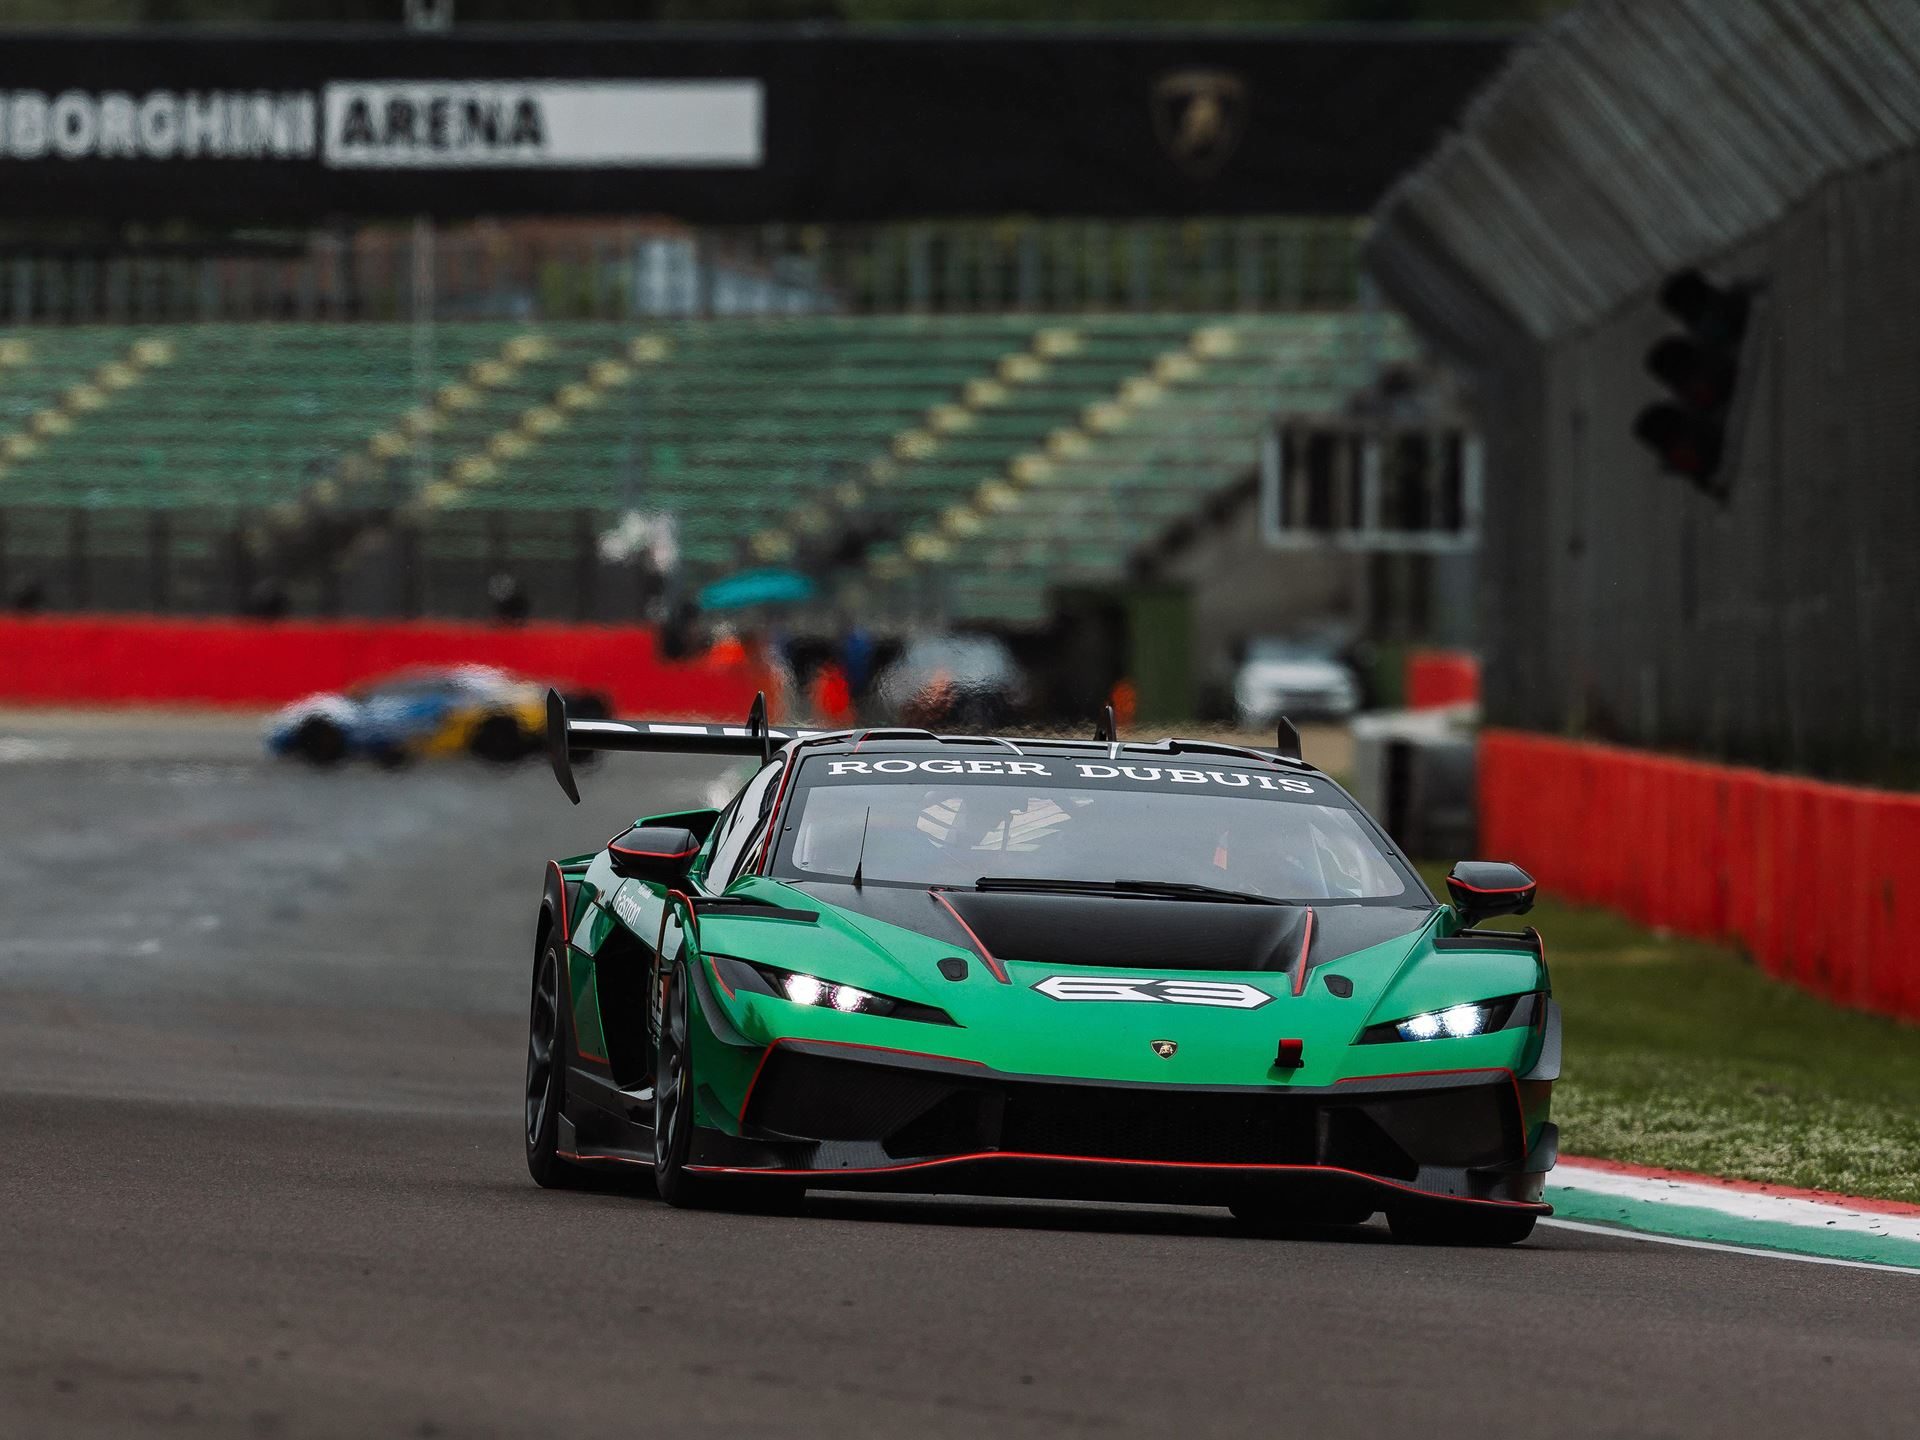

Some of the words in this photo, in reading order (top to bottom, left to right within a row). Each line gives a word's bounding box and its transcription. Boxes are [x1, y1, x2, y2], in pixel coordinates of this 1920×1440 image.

[0, 90, 314, 158] BORGHINI
[340, 96, 547, 148] ARENA
[827, 758, 1052, 777] ROGER
[1079, 763, 1316, 795] DUBUIS
